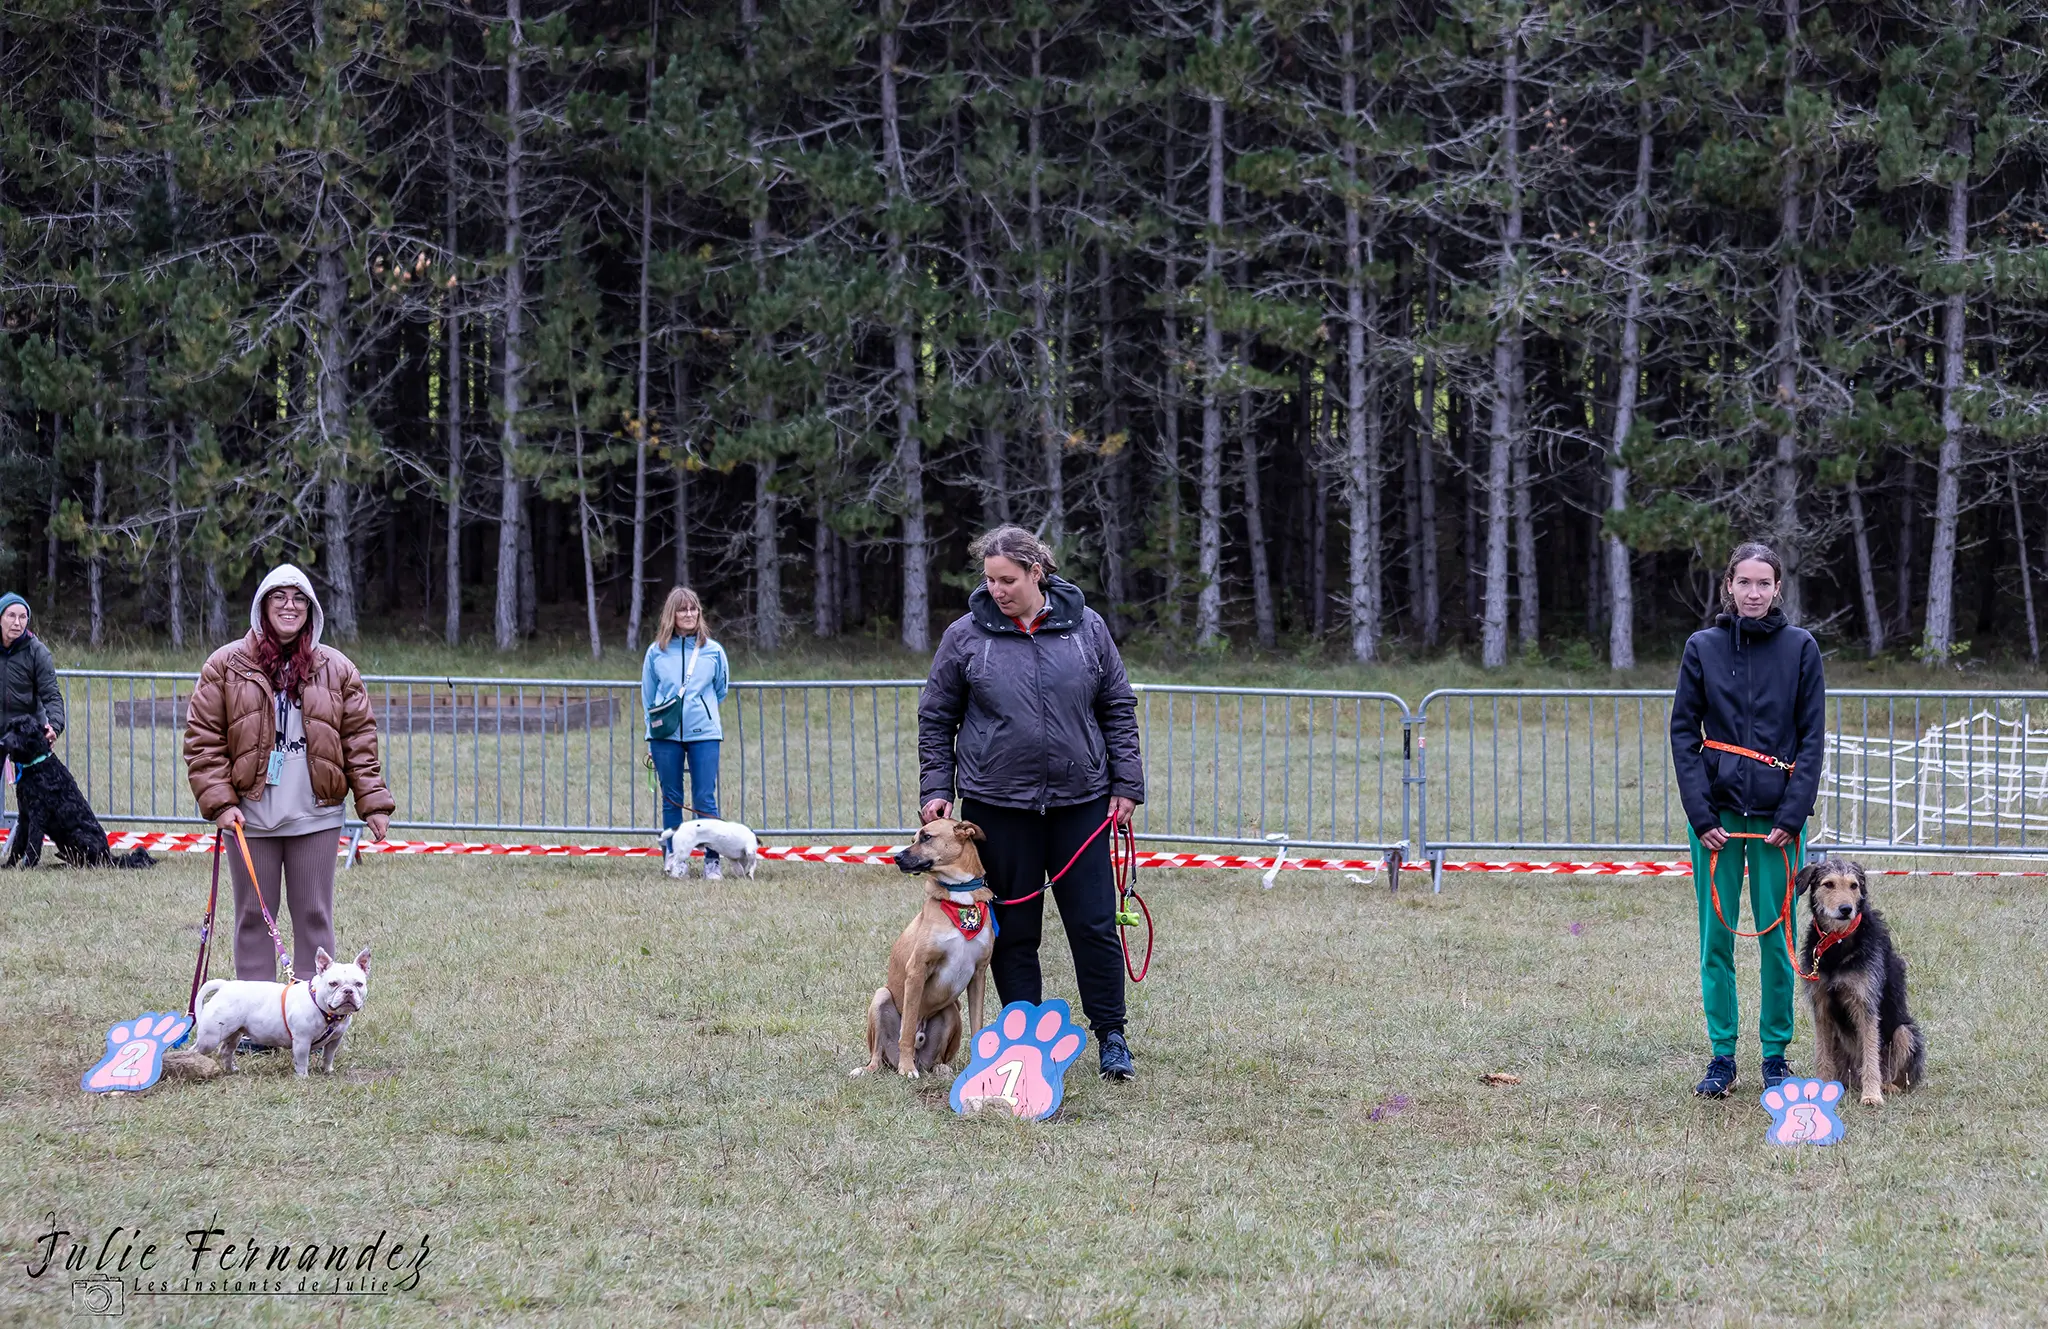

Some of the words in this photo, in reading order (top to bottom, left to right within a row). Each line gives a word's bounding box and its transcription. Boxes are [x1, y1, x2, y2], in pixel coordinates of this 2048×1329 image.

[111, 1042, 149, 1077] 2
[996, 1060, 1023, 1107] 1
[1792, 1108, 1816, 1139] 3
